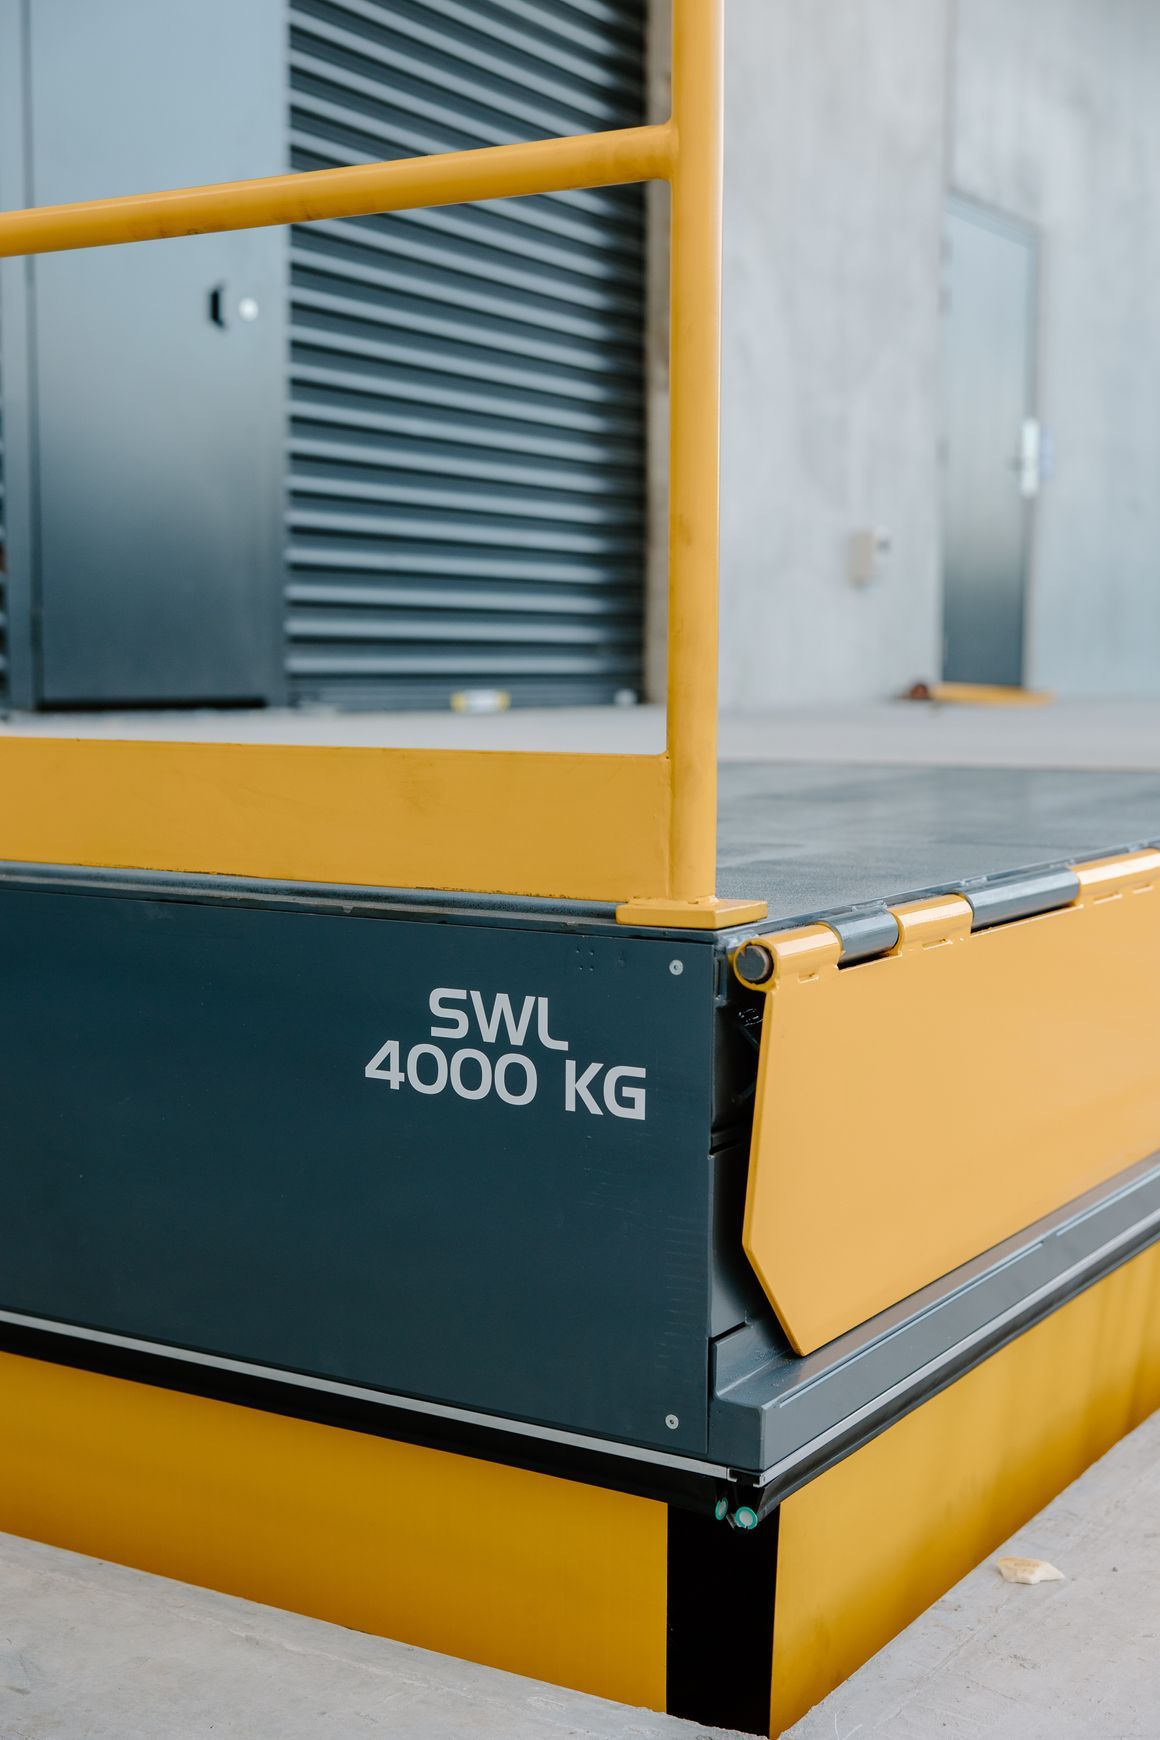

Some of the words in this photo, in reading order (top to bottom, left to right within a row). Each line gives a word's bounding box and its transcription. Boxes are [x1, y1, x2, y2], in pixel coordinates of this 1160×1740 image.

[429, 987, 569, 1051] SWL
[364, 1039, 538, 1106] 4000
[565, 1059, 647, 1121] KG
